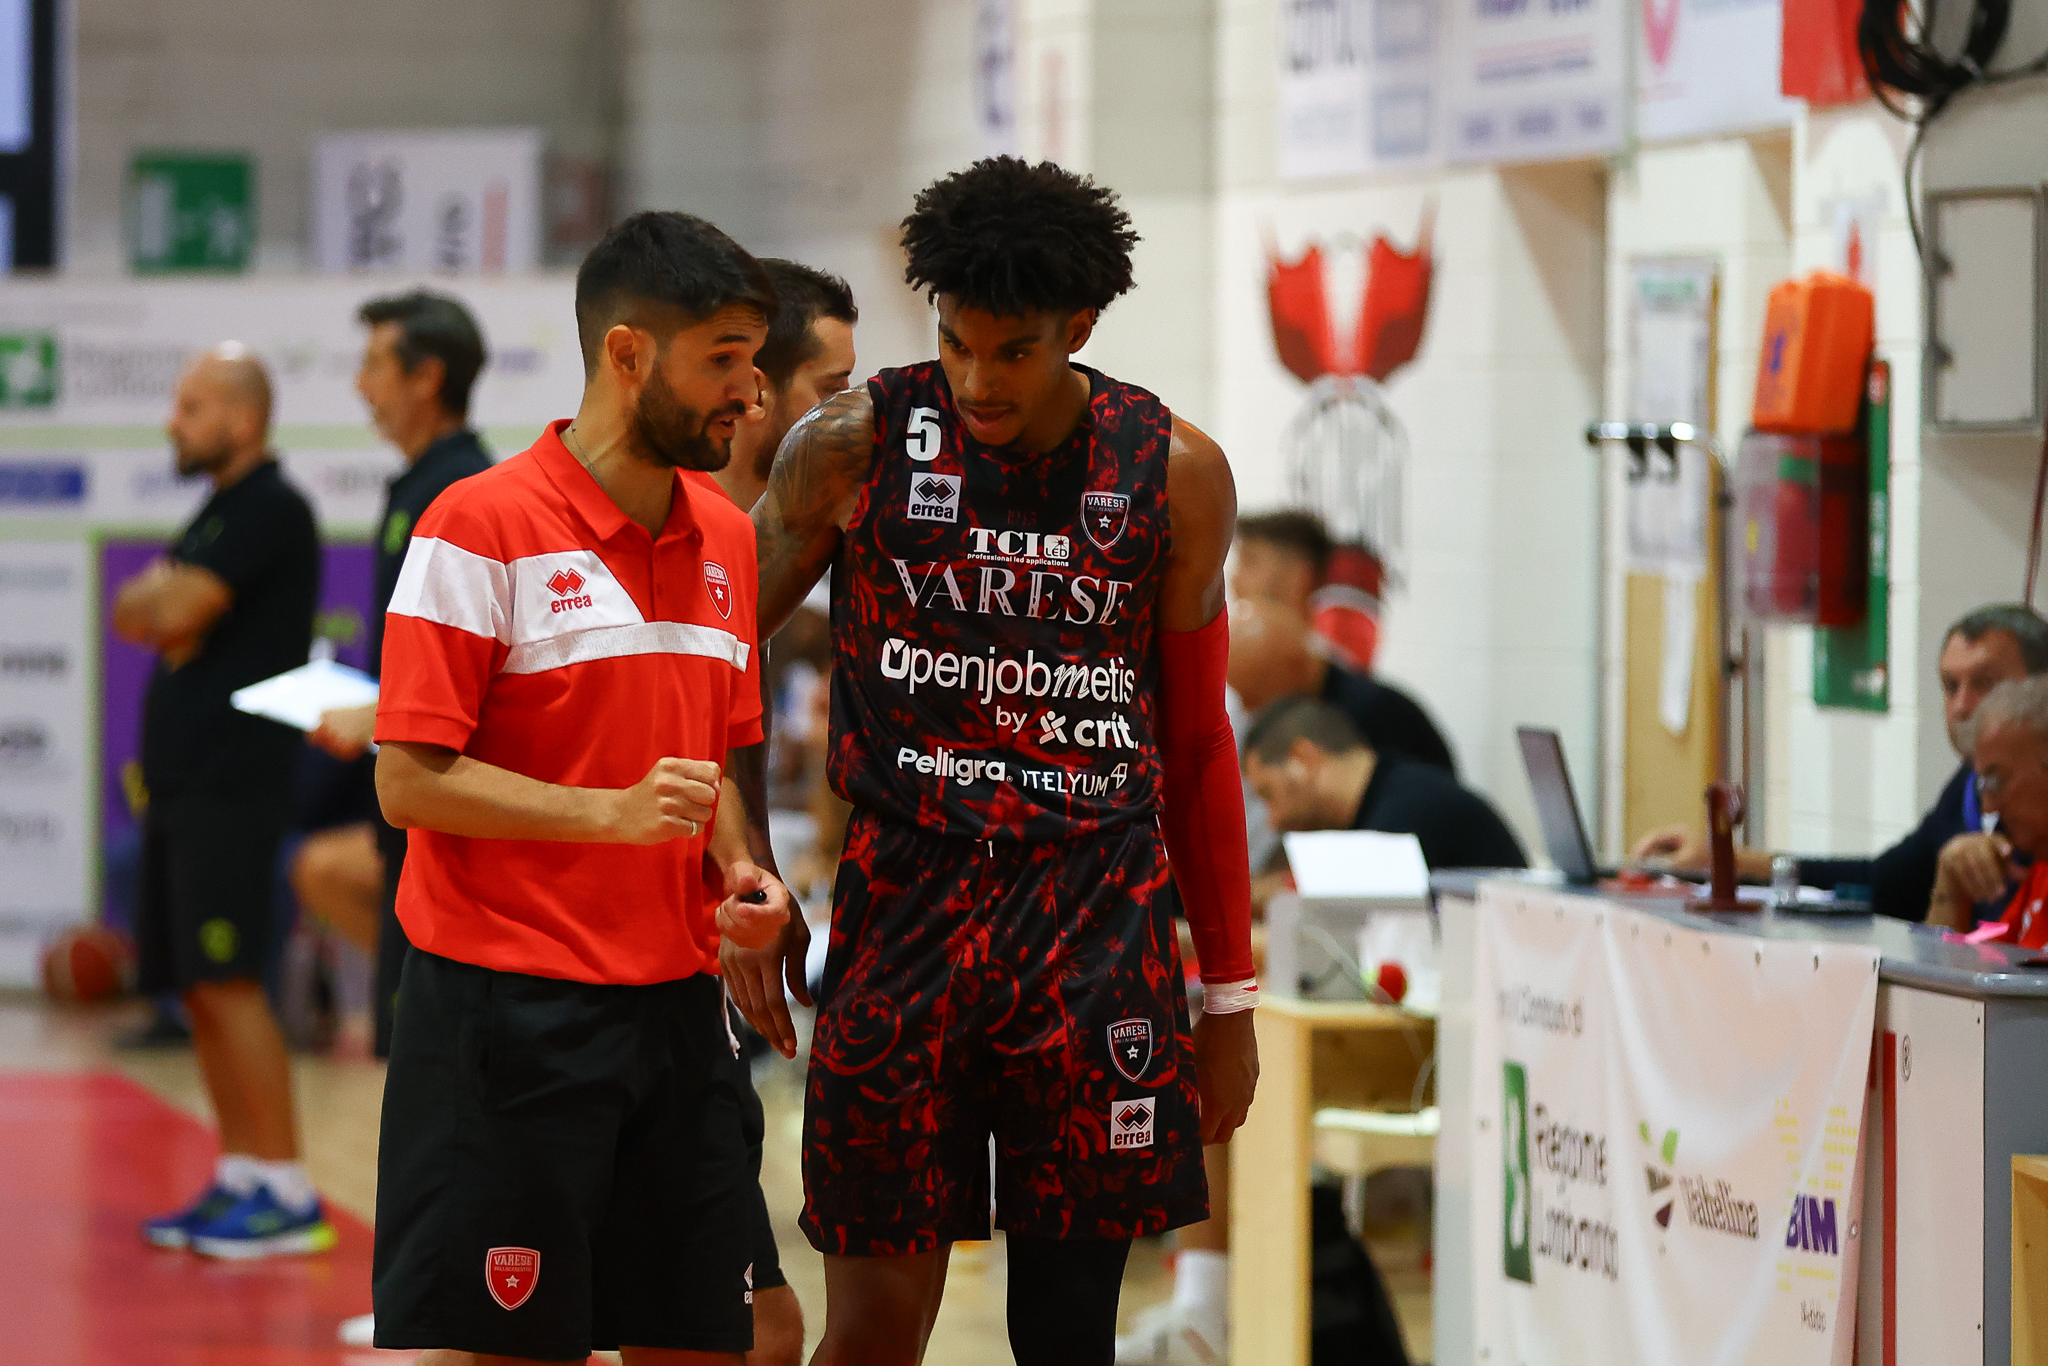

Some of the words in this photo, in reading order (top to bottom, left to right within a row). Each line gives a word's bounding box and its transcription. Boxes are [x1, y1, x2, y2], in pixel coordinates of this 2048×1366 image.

[905, 406, 942, 462] 5
[1086, 496, 1125, 508] VARESE
[969, 527, 1041, 558] TCI
[1045, 547, 1068, 558] LED
[967, 553, 1013, 563] professional
[1026, 557, 1069, 567] applications
[892, 558, 1133, 625] VARESE
[880, 638, 1135, 705] Openjobmetis
[995, 706, 1028, 733] by
[1021, 769, 1110, 797] ITELYUM
[1113, 1025, 1148, 1039] VARESE
[1786, 1191, 1838, 1255] BIM
[493, 1254, 533, 1266] VARESE
